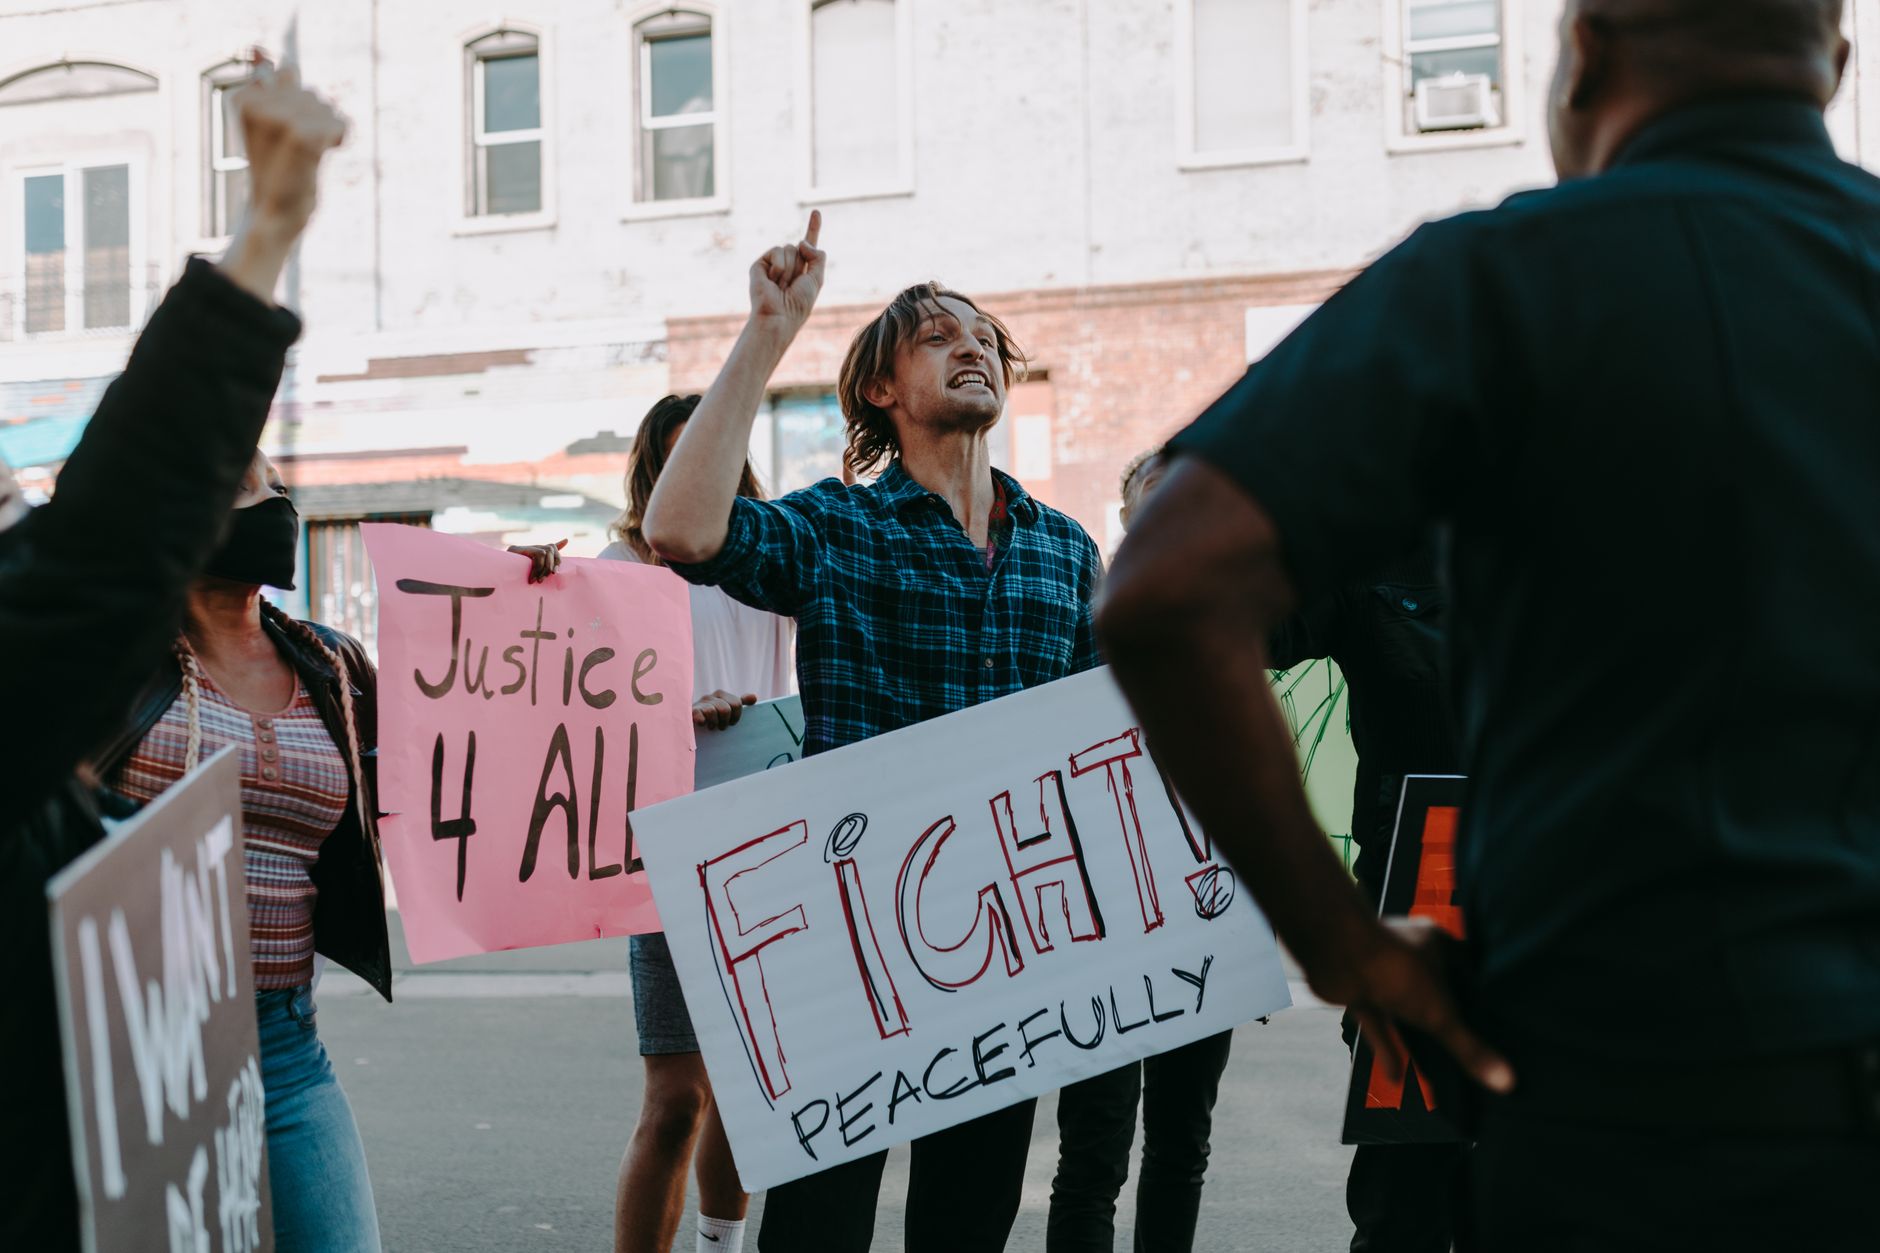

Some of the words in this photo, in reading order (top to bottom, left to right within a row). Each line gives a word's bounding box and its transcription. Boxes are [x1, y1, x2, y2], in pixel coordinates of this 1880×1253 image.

[396, 578, 663, 709] Justice
[431, 730, 477, 902] 4
[519, 722, 646, 883] ALL
[790, 955, 1214, 1161] PEACEFULLY
